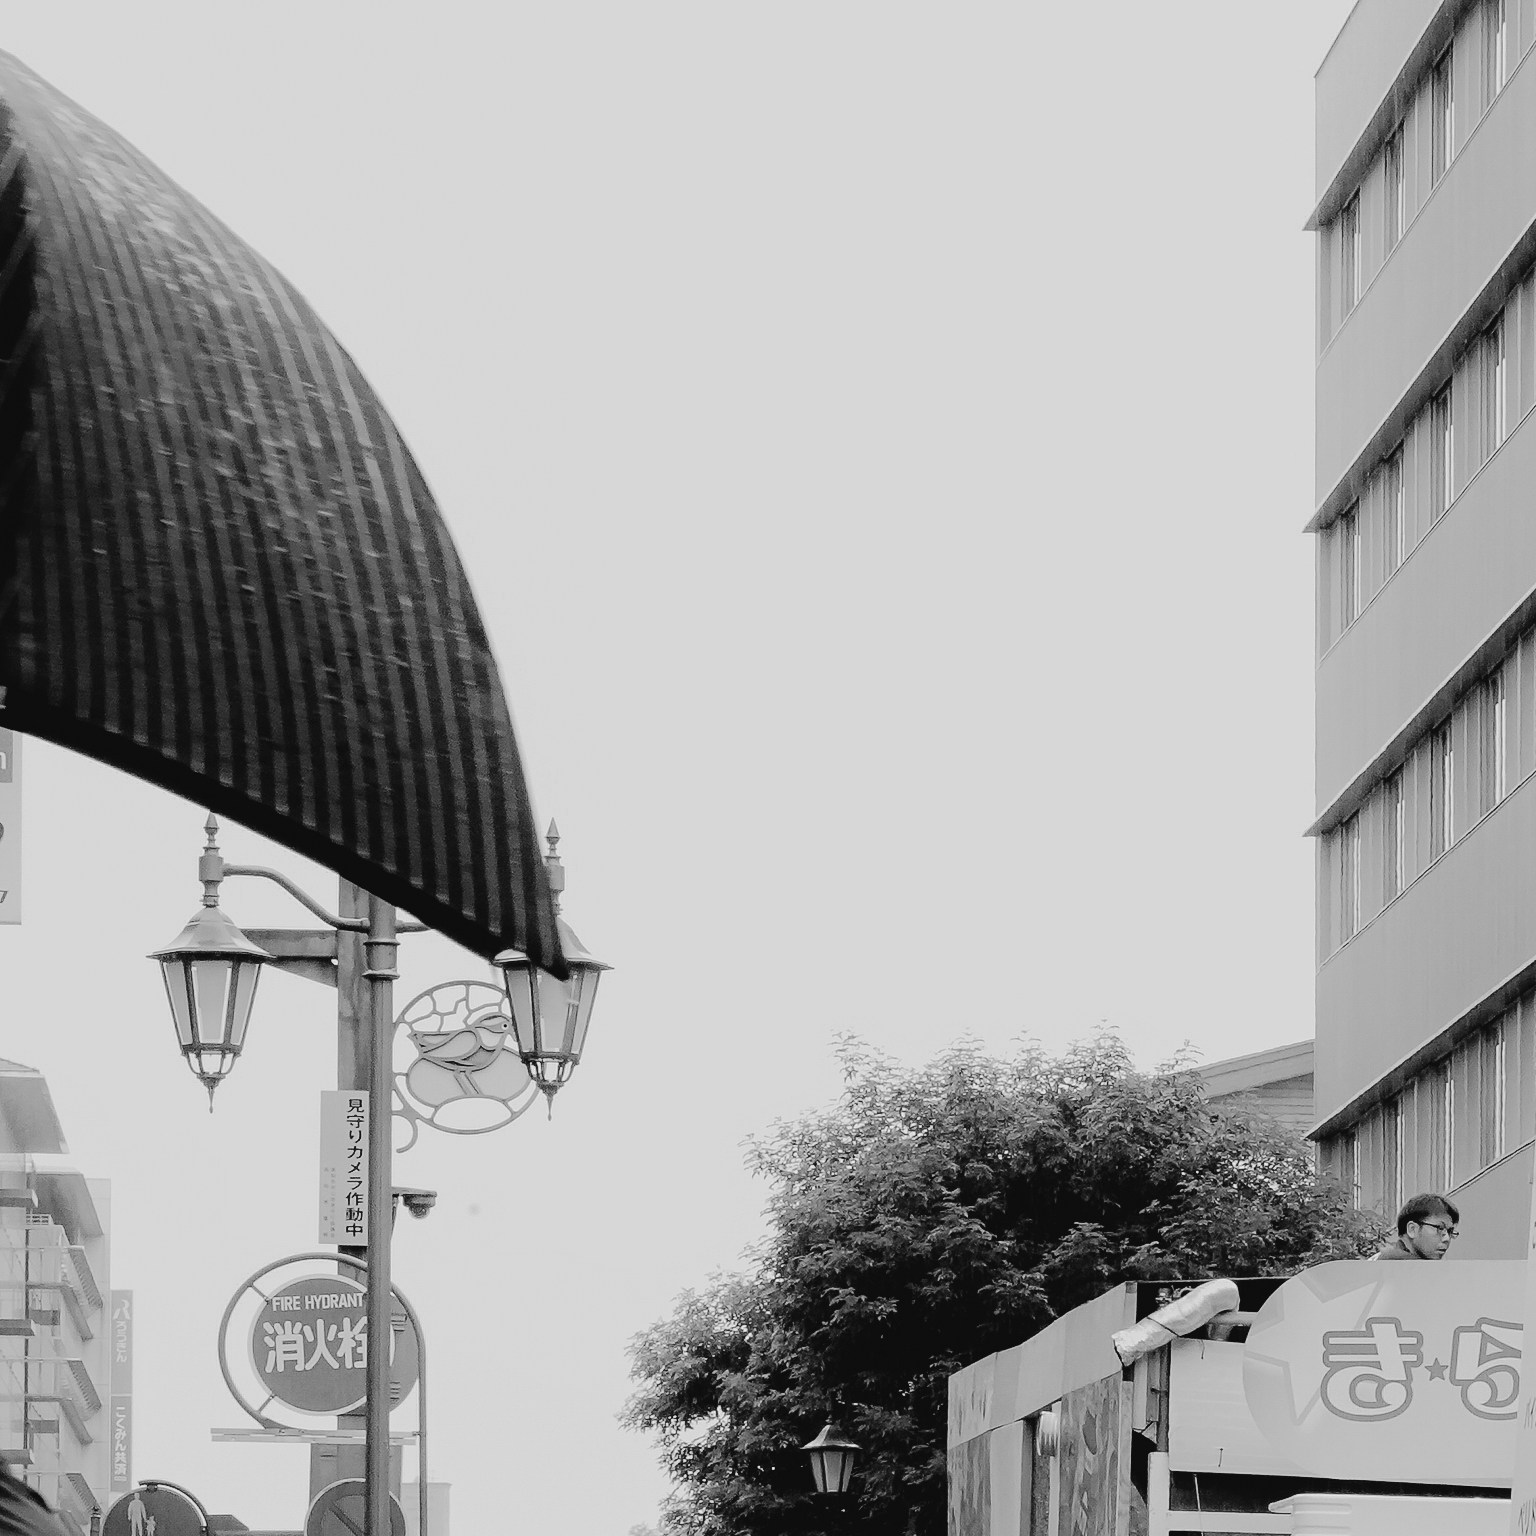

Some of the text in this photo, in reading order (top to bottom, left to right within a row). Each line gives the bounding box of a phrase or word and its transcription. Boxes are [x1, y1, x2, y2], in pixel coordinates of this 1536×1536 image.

[345, 1098, 365, 1238] 見守りカメラ作動中
[272, 1292, 365, 1312] FIRE HYDRANT
